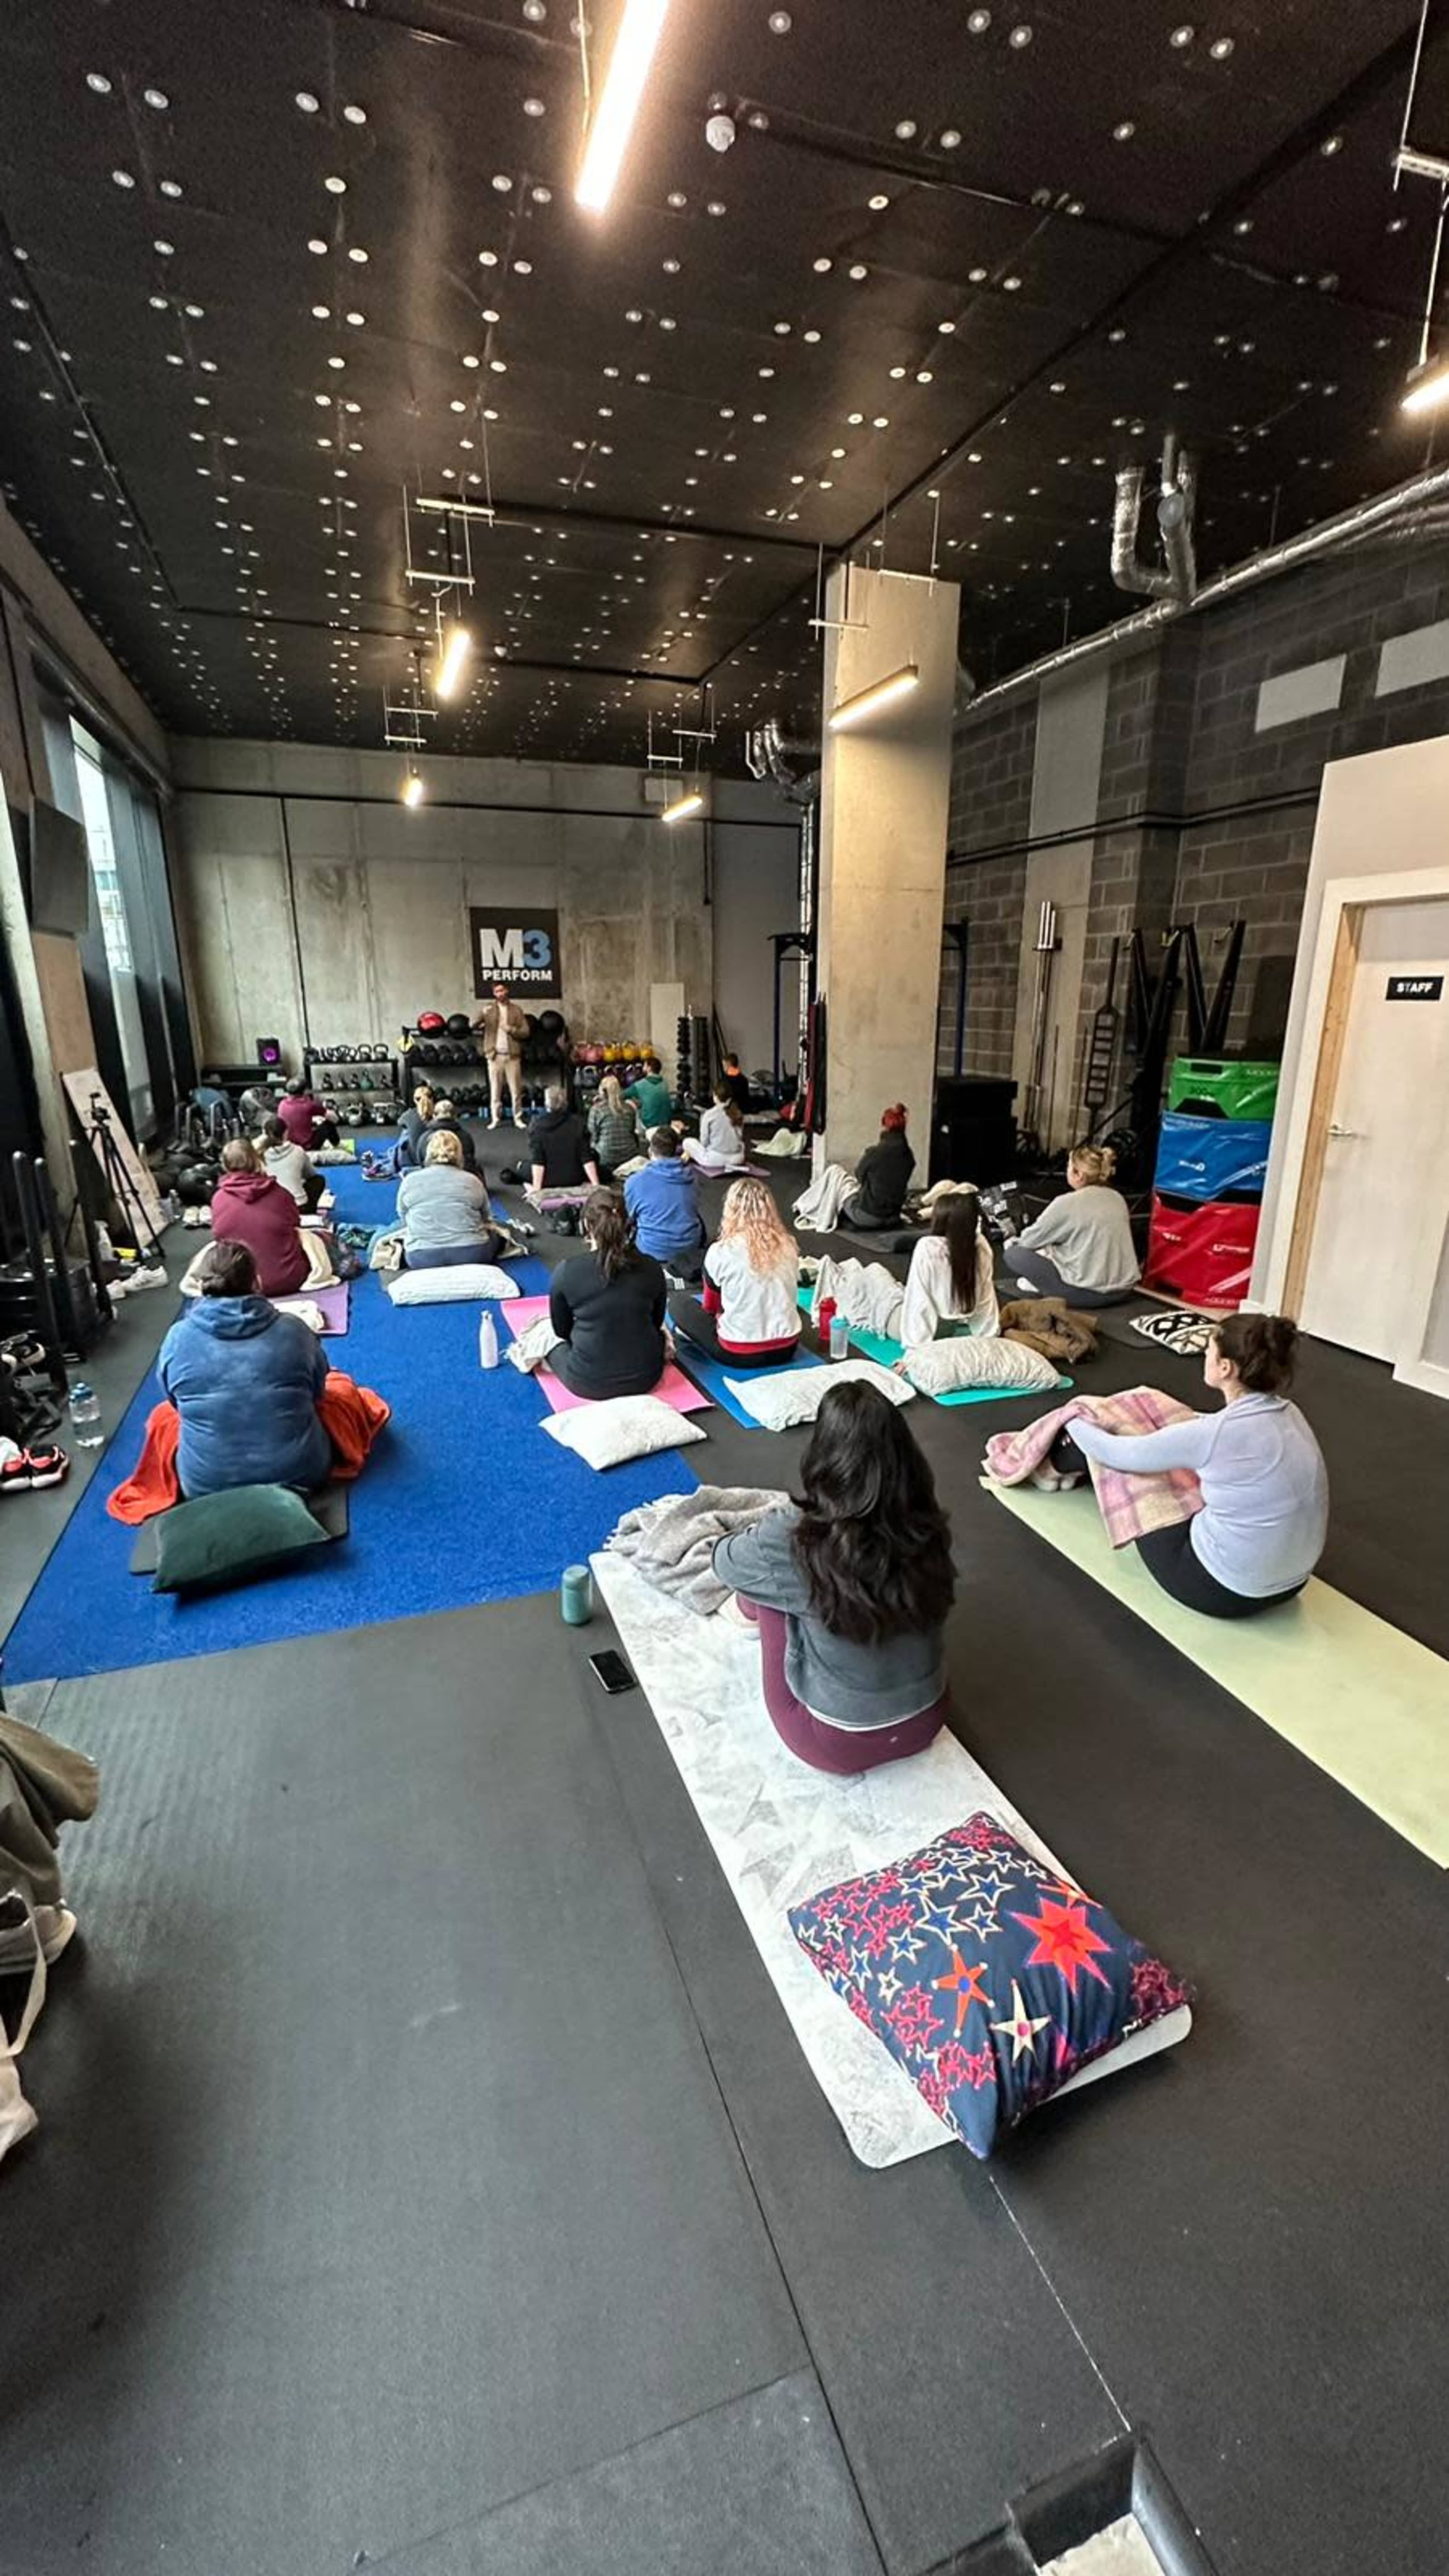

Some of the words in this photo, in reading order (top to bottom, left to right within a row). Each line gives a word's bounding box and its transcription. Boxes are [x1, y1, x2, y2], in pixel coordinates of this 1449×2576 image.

[479, 928, 552, 968] M3
[482, 969, 552, 981] PERFORM
[1397, 982, 1433, 993] STAFF
